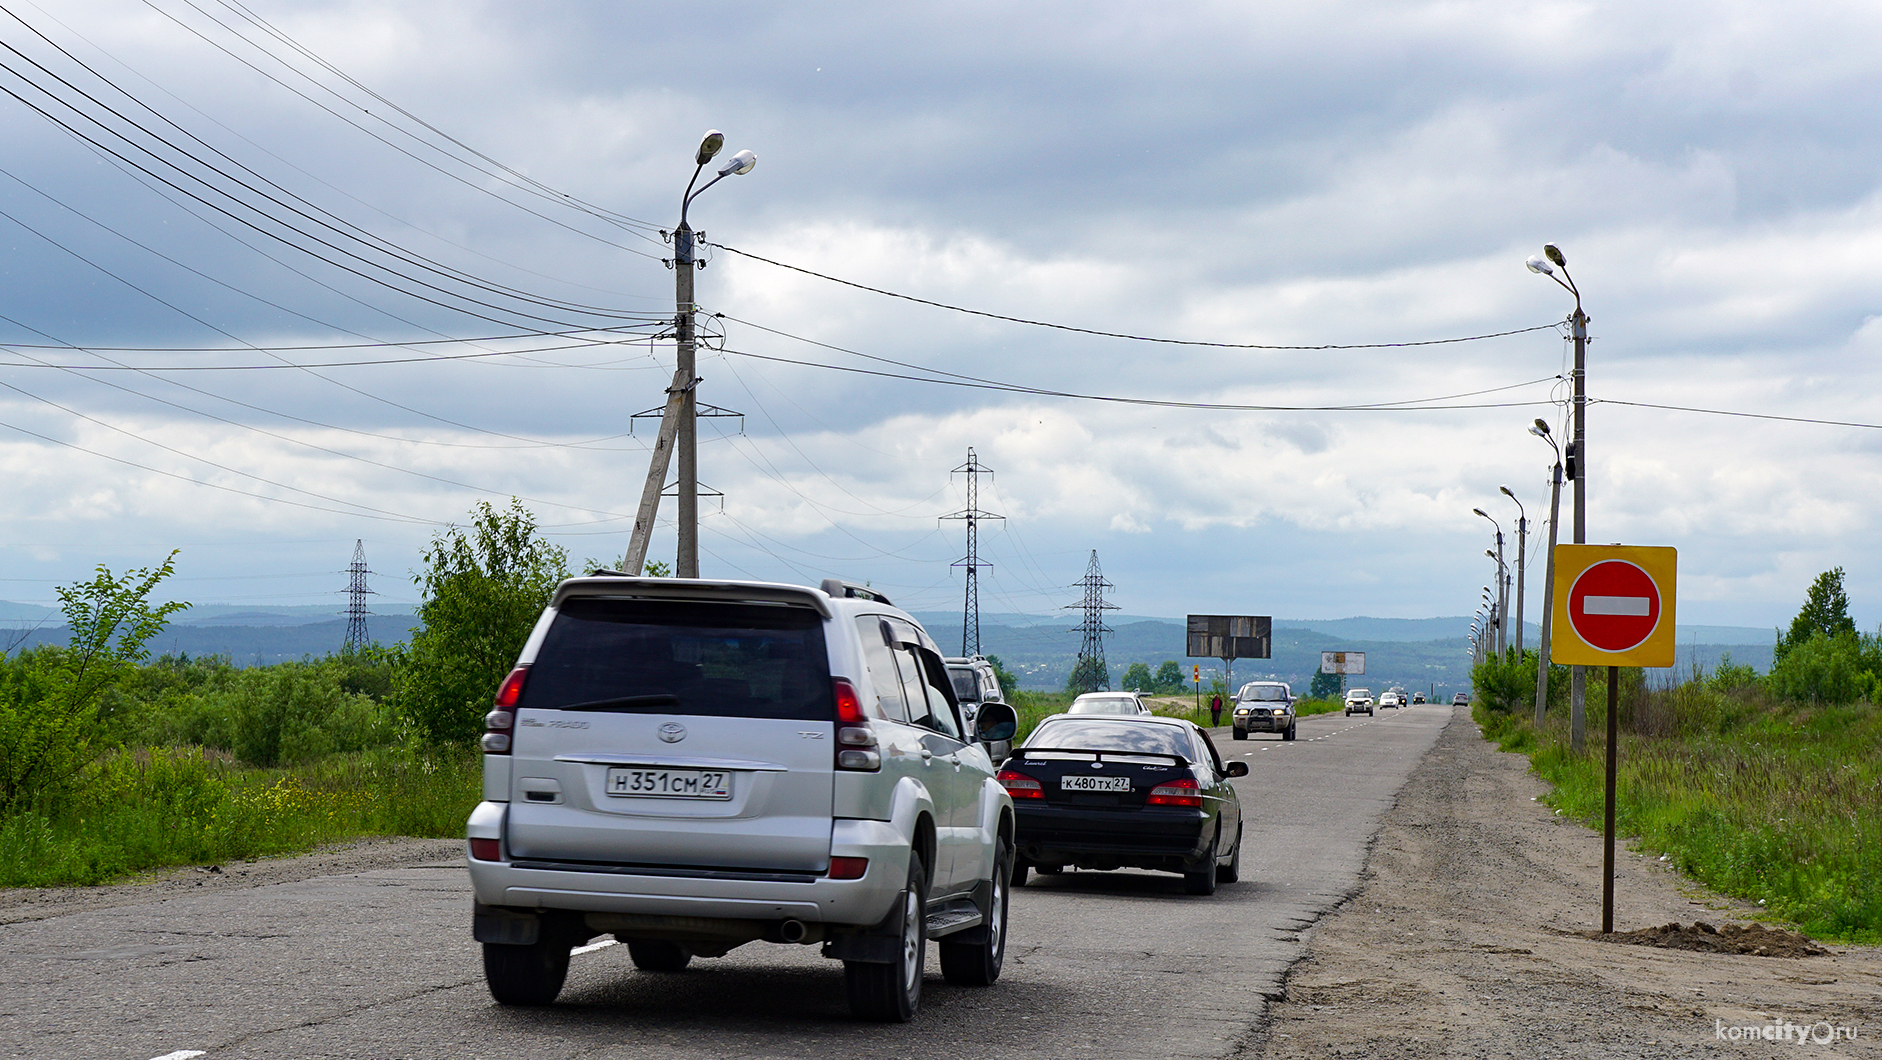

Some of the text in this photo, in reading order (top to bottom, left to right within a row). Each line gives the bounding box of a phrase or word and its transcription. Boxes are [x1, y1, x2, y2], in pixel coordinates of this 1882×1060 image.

[797, 731, 824, 740] TZ
[702, 773, 724, 789] 27
[1114, 778, 1126, 787] 27
